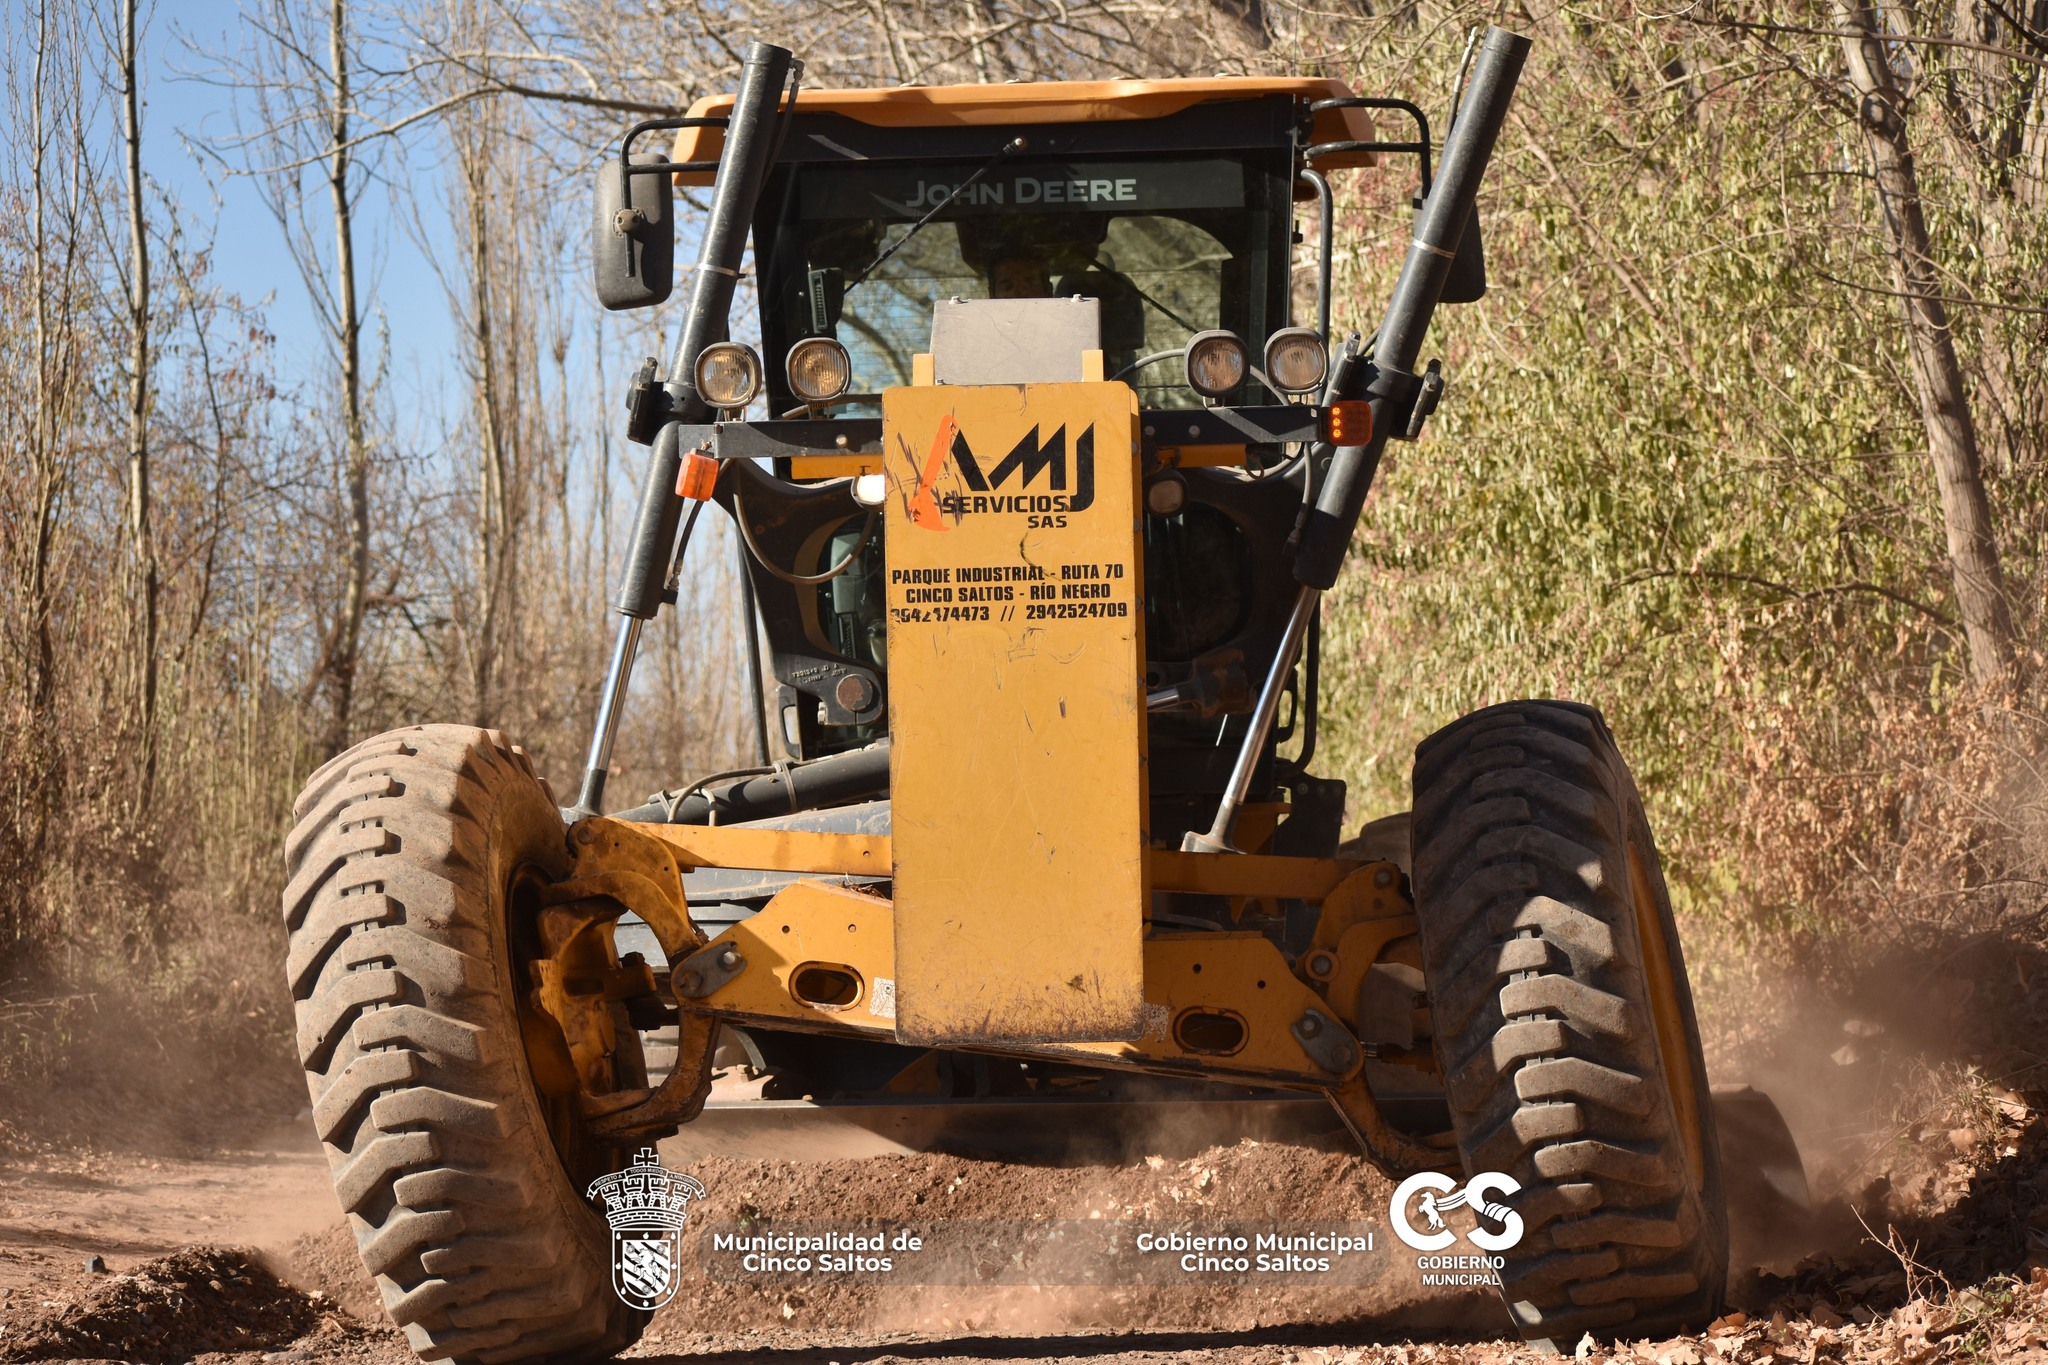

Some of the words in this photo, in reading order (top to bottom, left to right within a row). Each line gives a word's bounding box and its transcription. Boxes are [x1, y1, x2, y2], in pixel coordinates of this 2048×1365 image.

[906, 180, 1004, 207] JOHN
[1015, 177, 1137, 204] DEERE
[942, 495, 1068, 514] SERVICIOS
[1027, 515, 1068, 529] SAS
[892, 568, 951, 585] PARQUE
[956, 565, 1045, 583] INDUSTRIAL
[1061, 564, 1100, 580] RUTA
[1105, 563, 1124, 579] 70
[905, 588, 953, 604] CINCO
[958, 586, 1014, 602] SALTOS
[1030, 582, 1056, 600] RÍO
[1061, 583, 1111, 600] NEGRO
[1026, 602, 1128, 620] 2942524709
